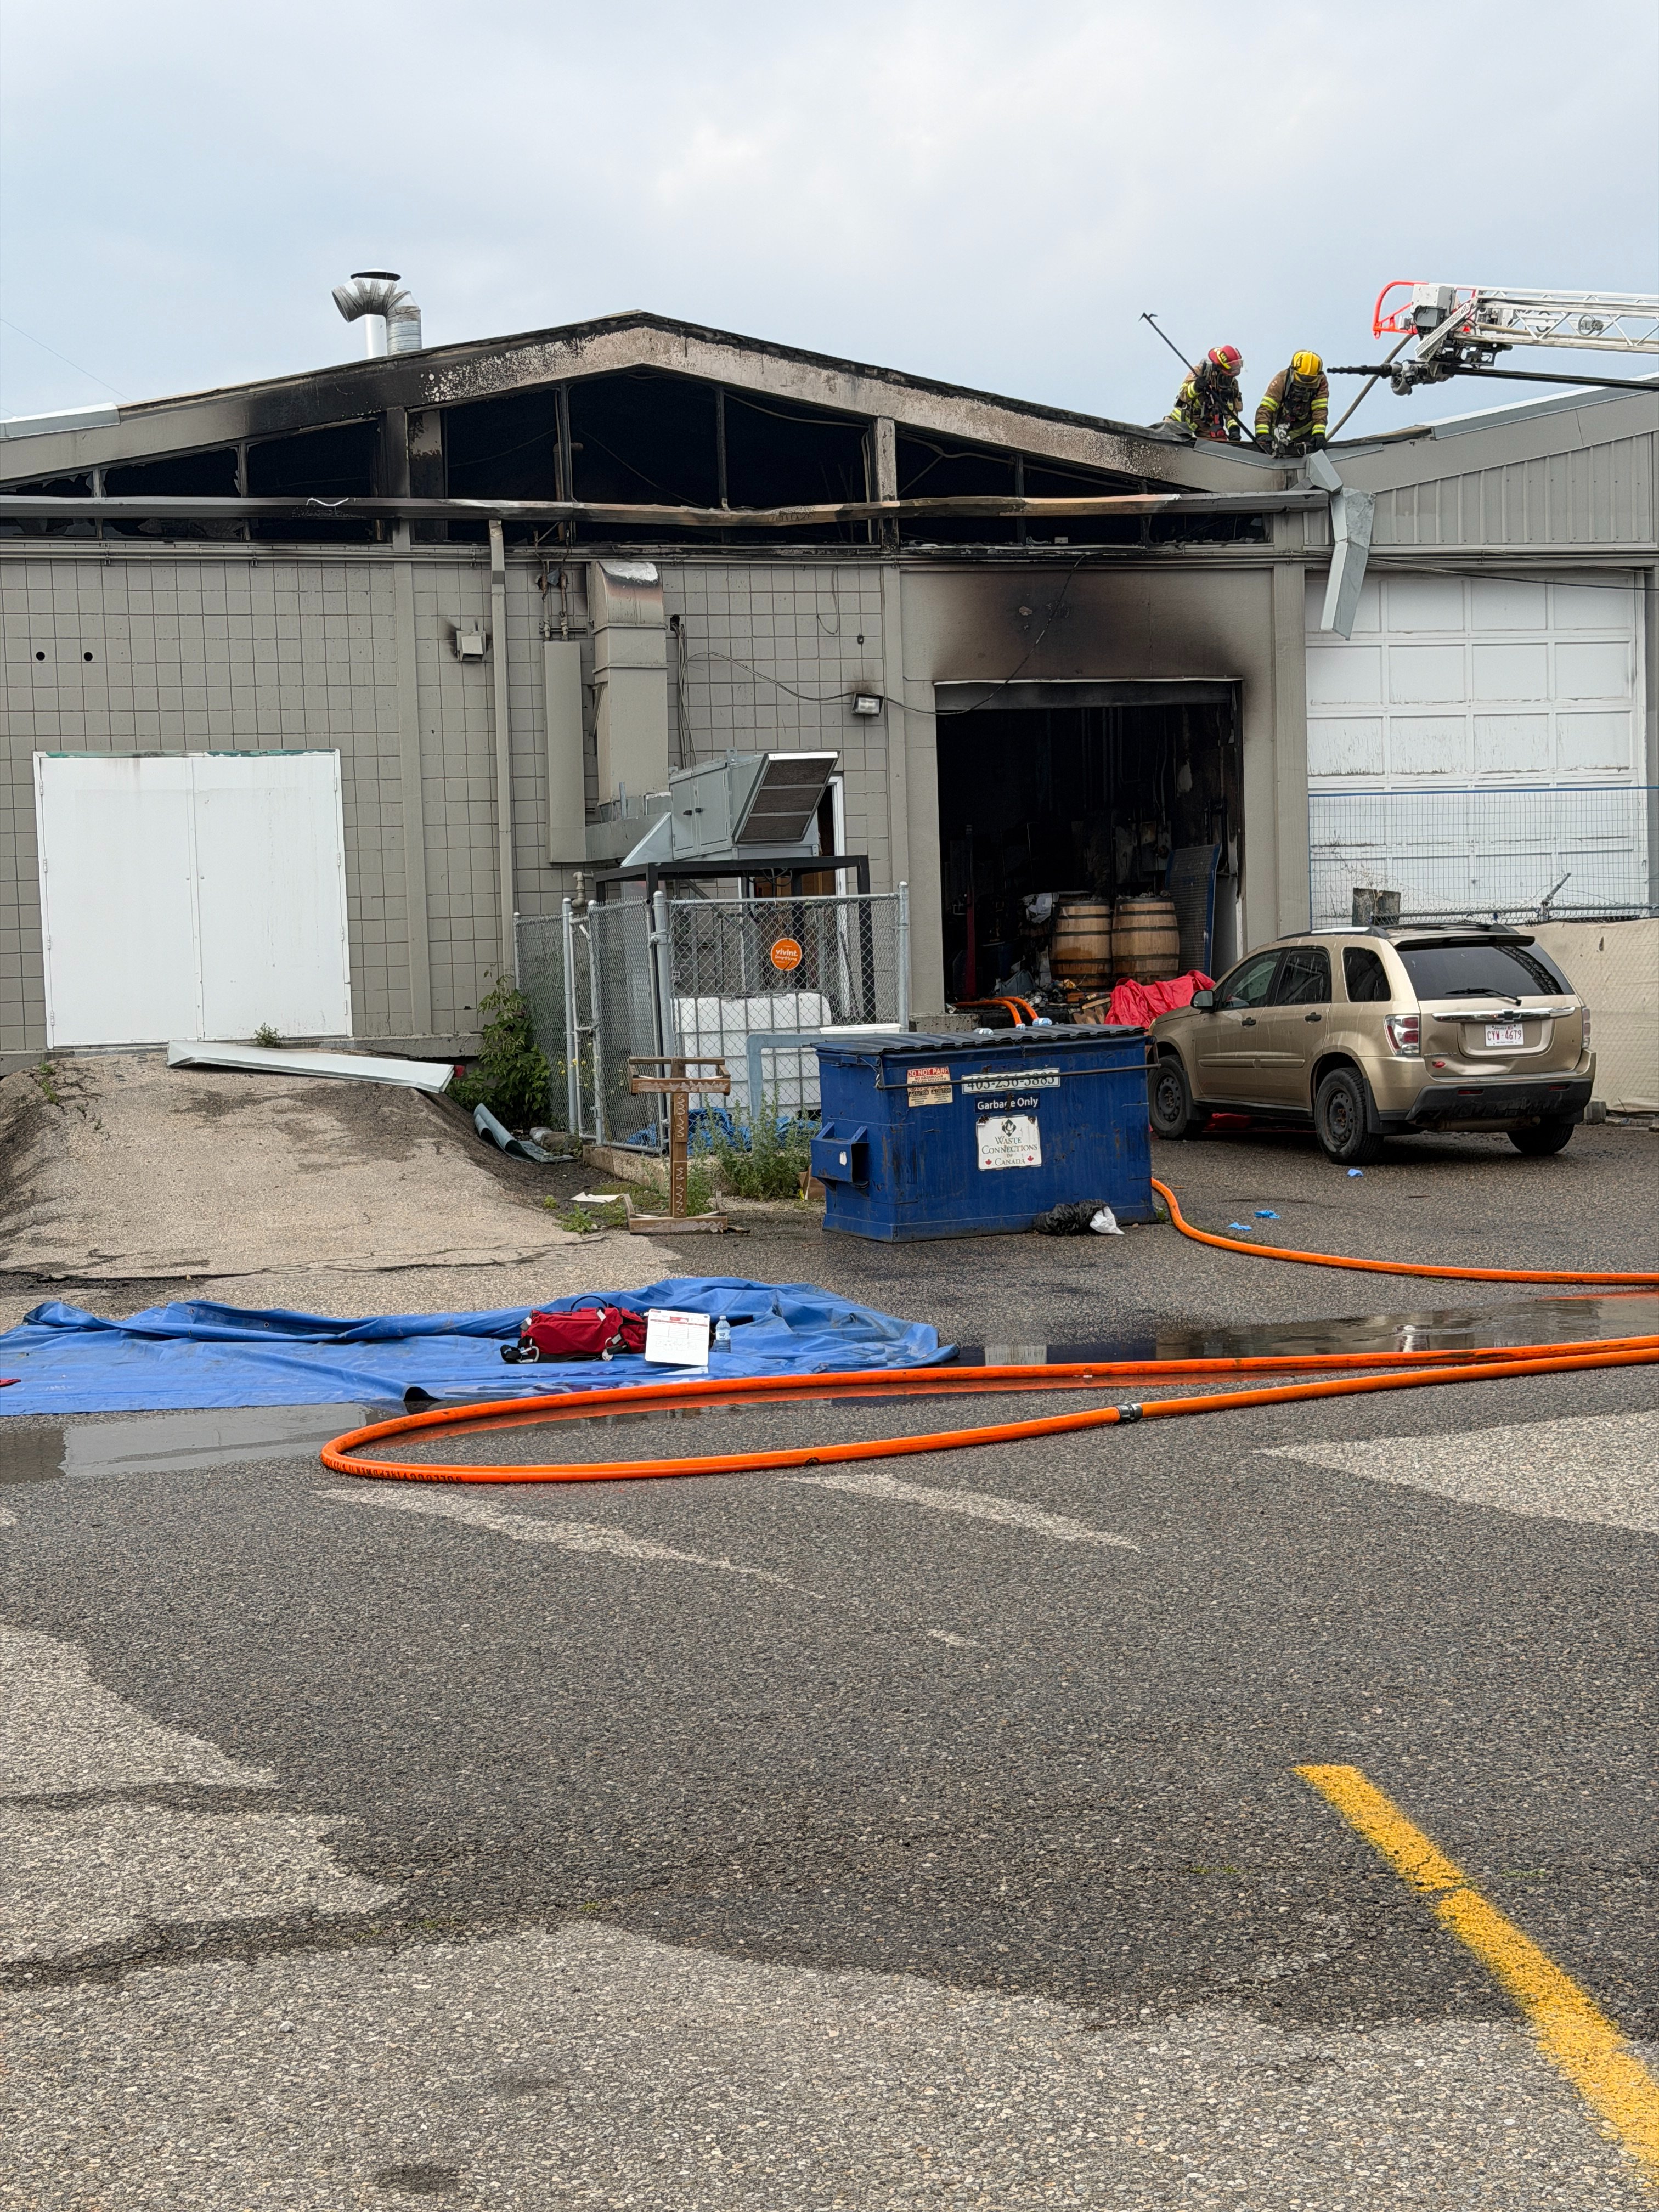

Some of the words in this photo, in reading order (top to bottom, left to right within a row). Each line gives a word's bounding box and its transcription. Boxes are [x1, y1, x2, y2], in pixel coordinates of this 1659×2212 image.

[1017, 1096, 1039, 1108] Only
[995, 1136, 1022, 1145] WASTE
[981, 1144, 1038, 1154] CONNECTIONS
[994, 1158, 1026, 1166] CANADA
